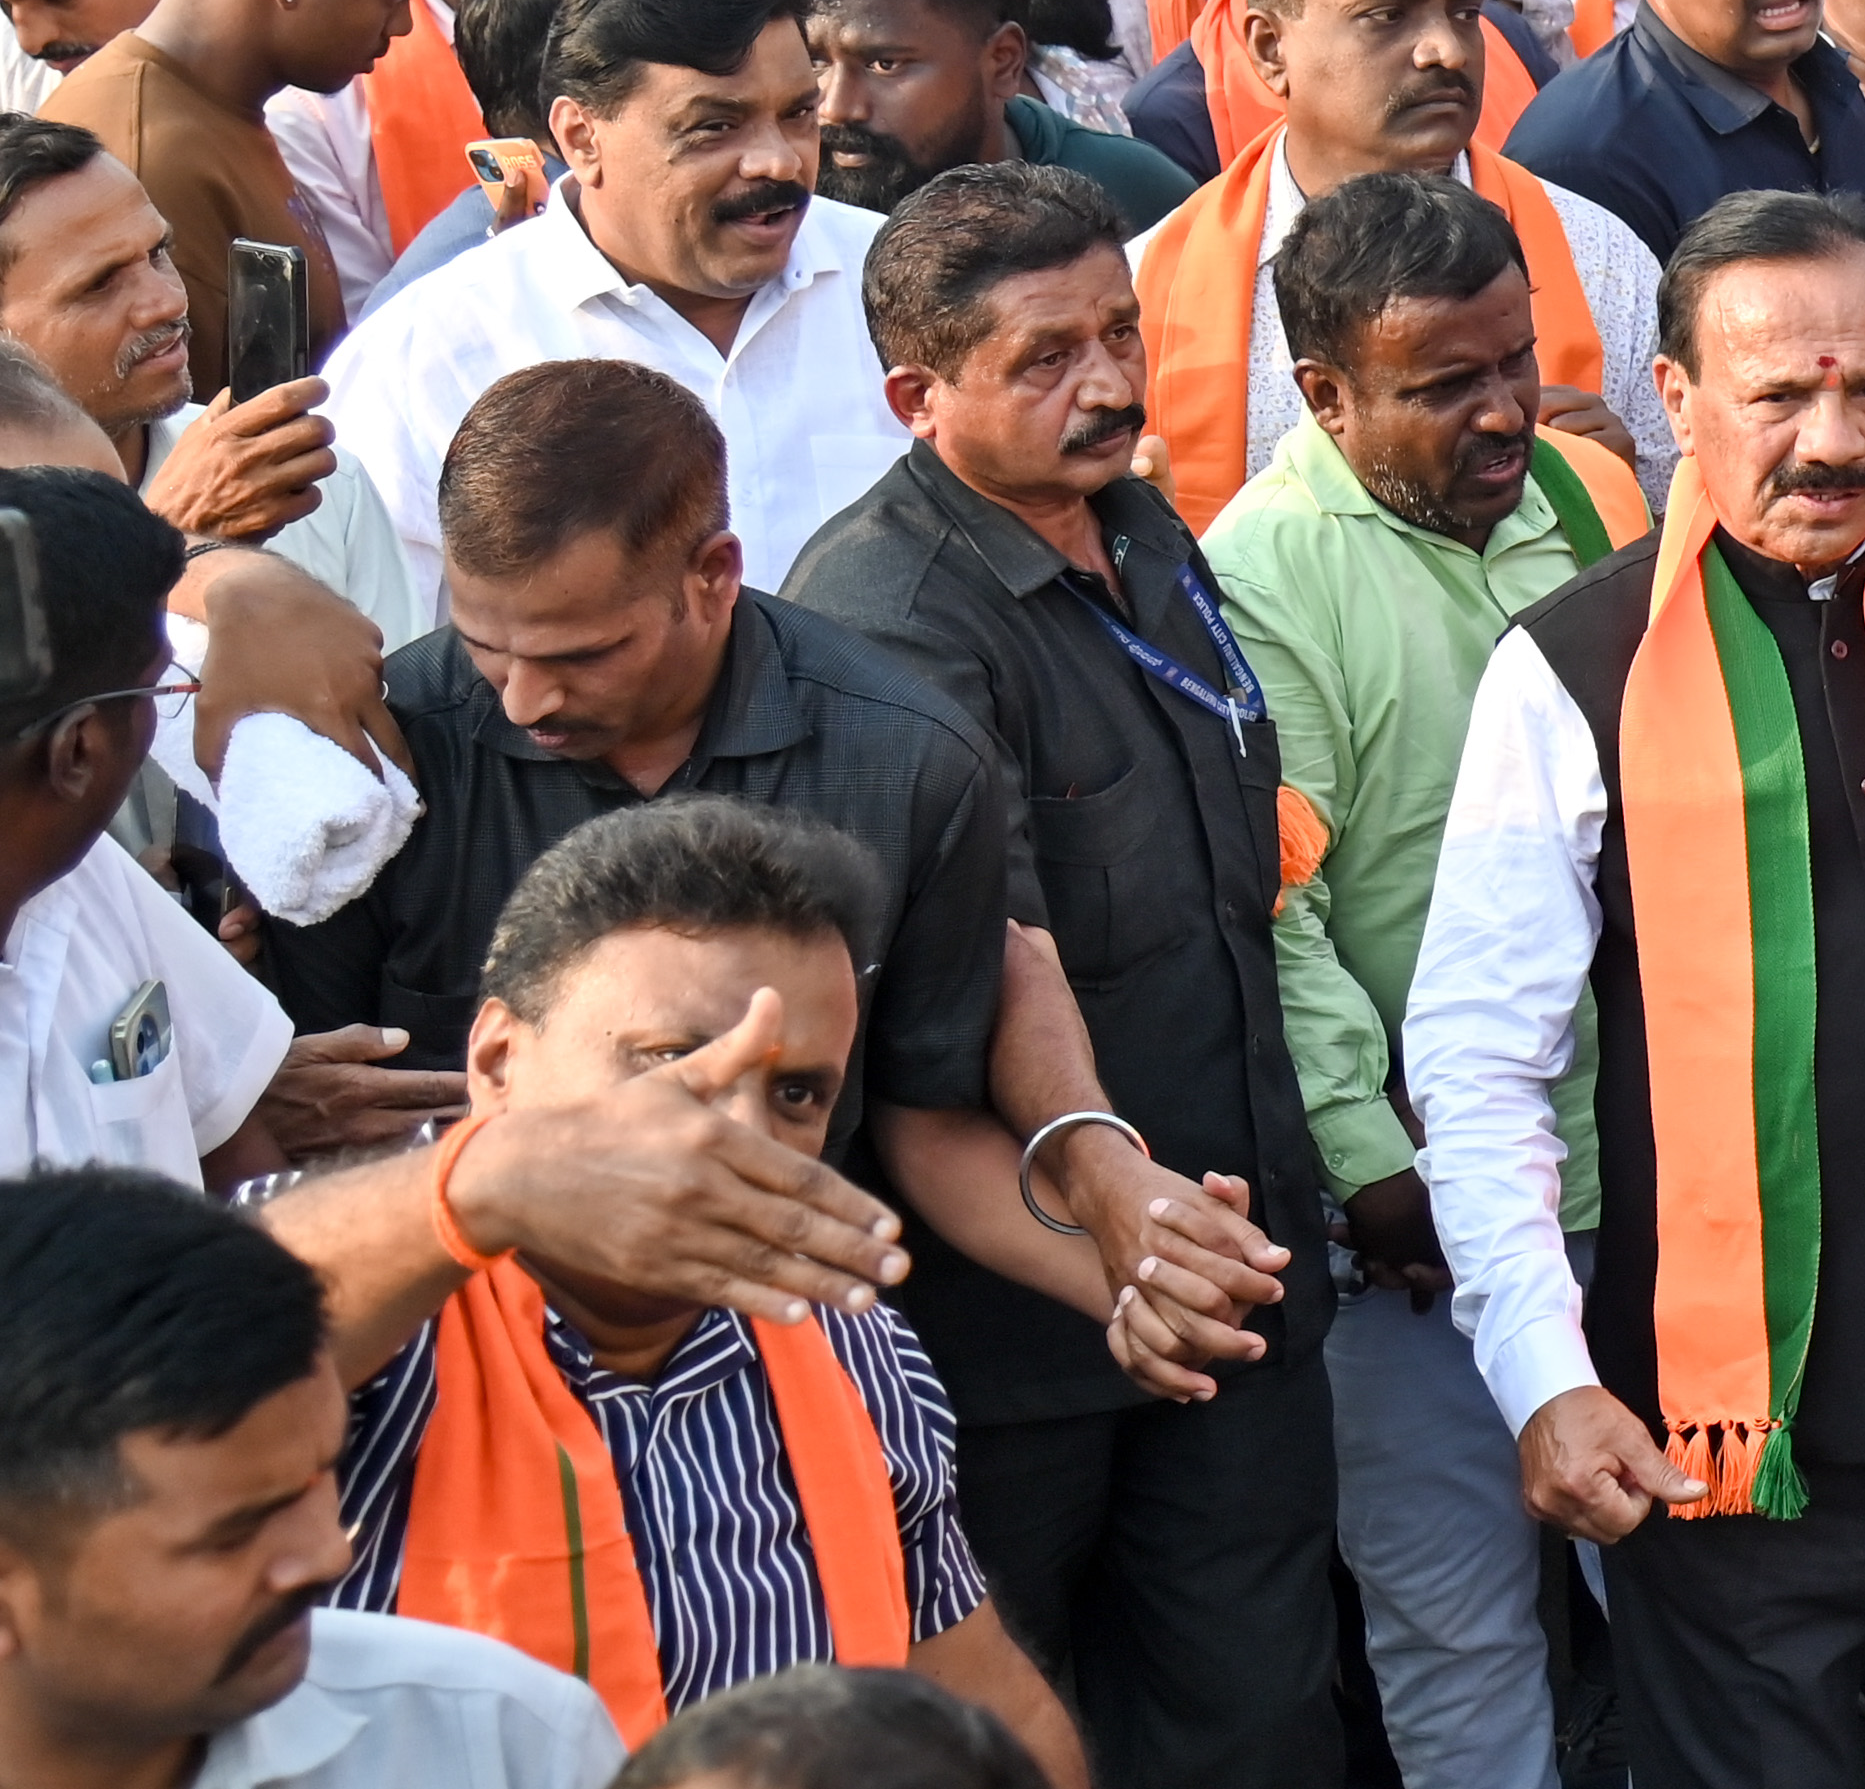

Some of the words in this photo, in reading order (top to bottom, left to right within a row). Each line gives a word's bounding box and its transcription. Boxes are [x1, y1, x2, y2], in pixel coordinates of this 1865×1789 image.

[502, 154, 538, 172] BOSS
[1192, 591, 1215, 626] POLICE
[1210, 624, 1228, 647] CITY
[1223, 644, 1255, 695] BENGALURU
[1180, 677, 1217, 708] BENGALURU
